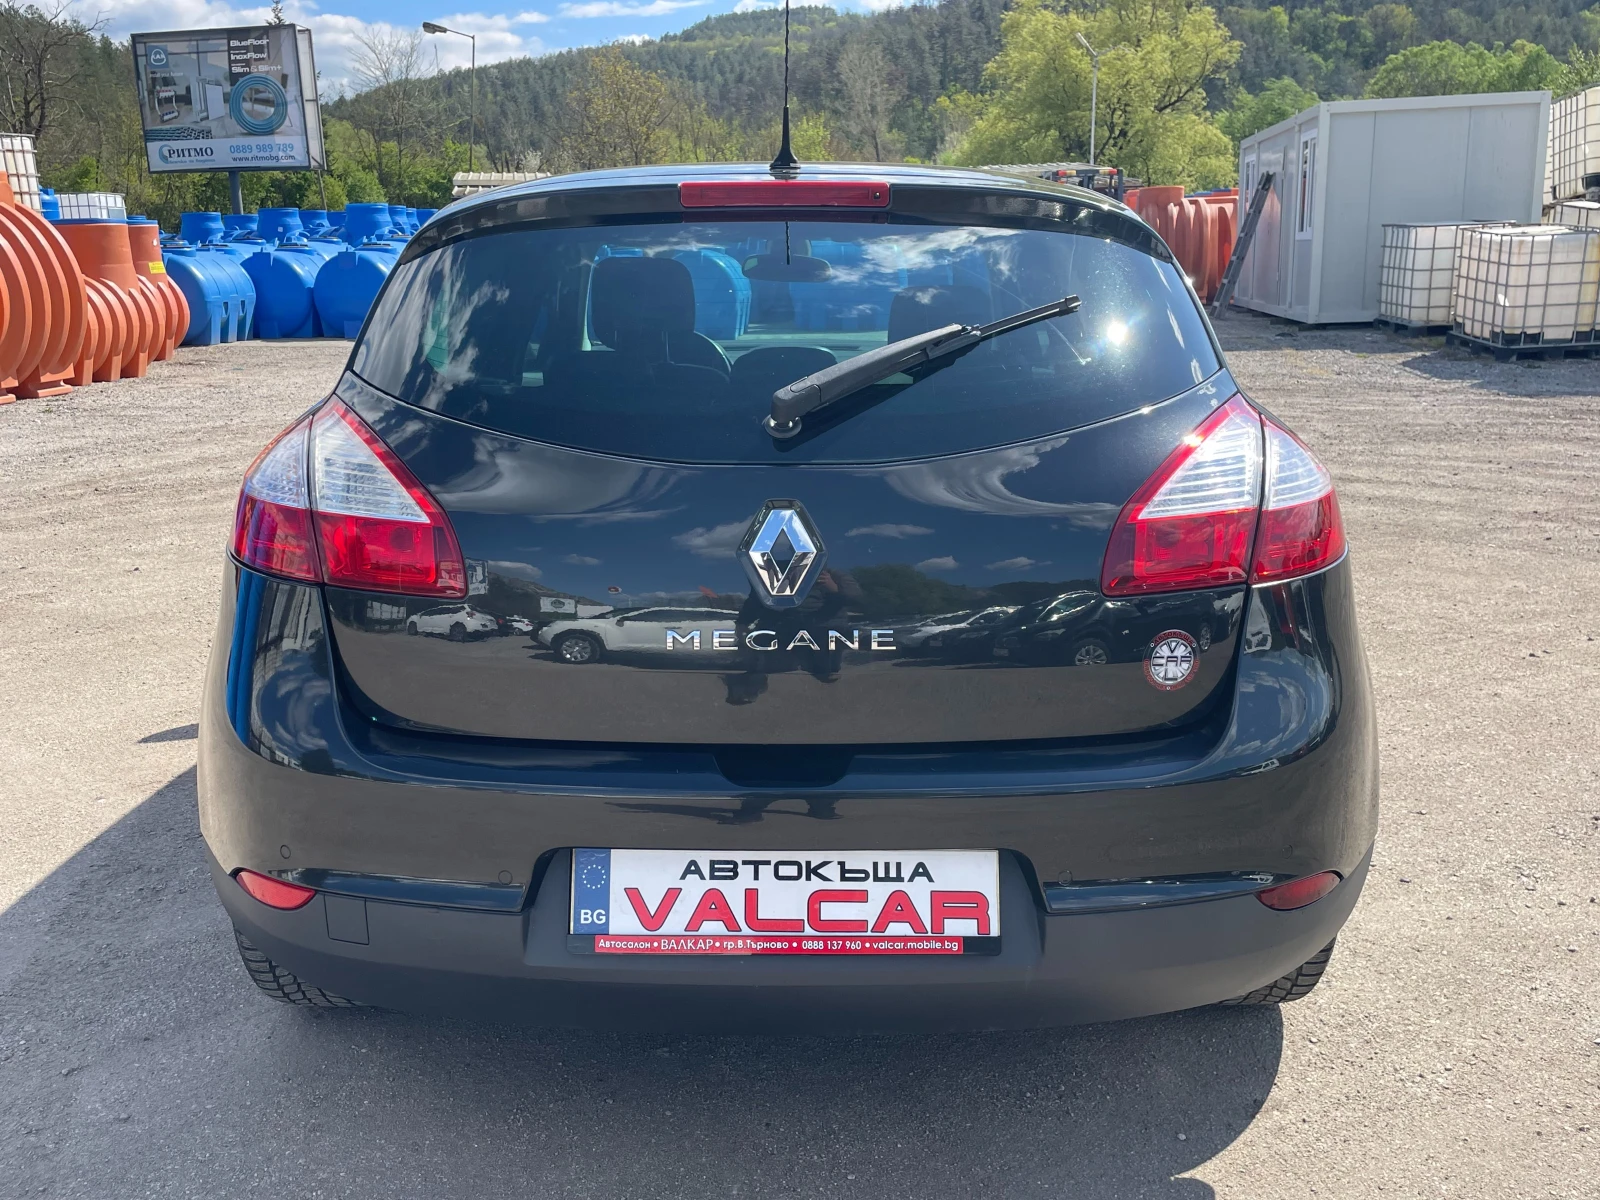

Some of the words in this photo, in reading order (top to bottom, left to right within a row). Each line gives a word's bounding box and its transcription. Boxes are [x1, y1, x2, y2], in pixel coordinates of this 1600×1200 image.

[230, 38, 270, 47] BlueFloor
[230, 52, 267, 60] InoxFlow
[167, 146, 214, 158] РИТМО
[229, 144, 253, 153] 0889
[255, 143, 273, 153] 989
[276, 142, 294, 152] 789
[231, 153, 296, 162] www.ritmobg.com
[665, 629, 897, 651] MEGANE
[679, 859, 934, 883] АВТОКЪЩА
[580, 908, 606, 924] BG
[624, 888, 991, 935] VALCAR
[598, 939, 651, 950] Автосалон
[661, 938, 713, 951] ВАЛКАР
[801, 940, 824, 950] 0888
[827, 940, 843, 950] 137
[845, 940, 862, 950] 960
[872, 939, 959, 953] valcar.mobile.bg
